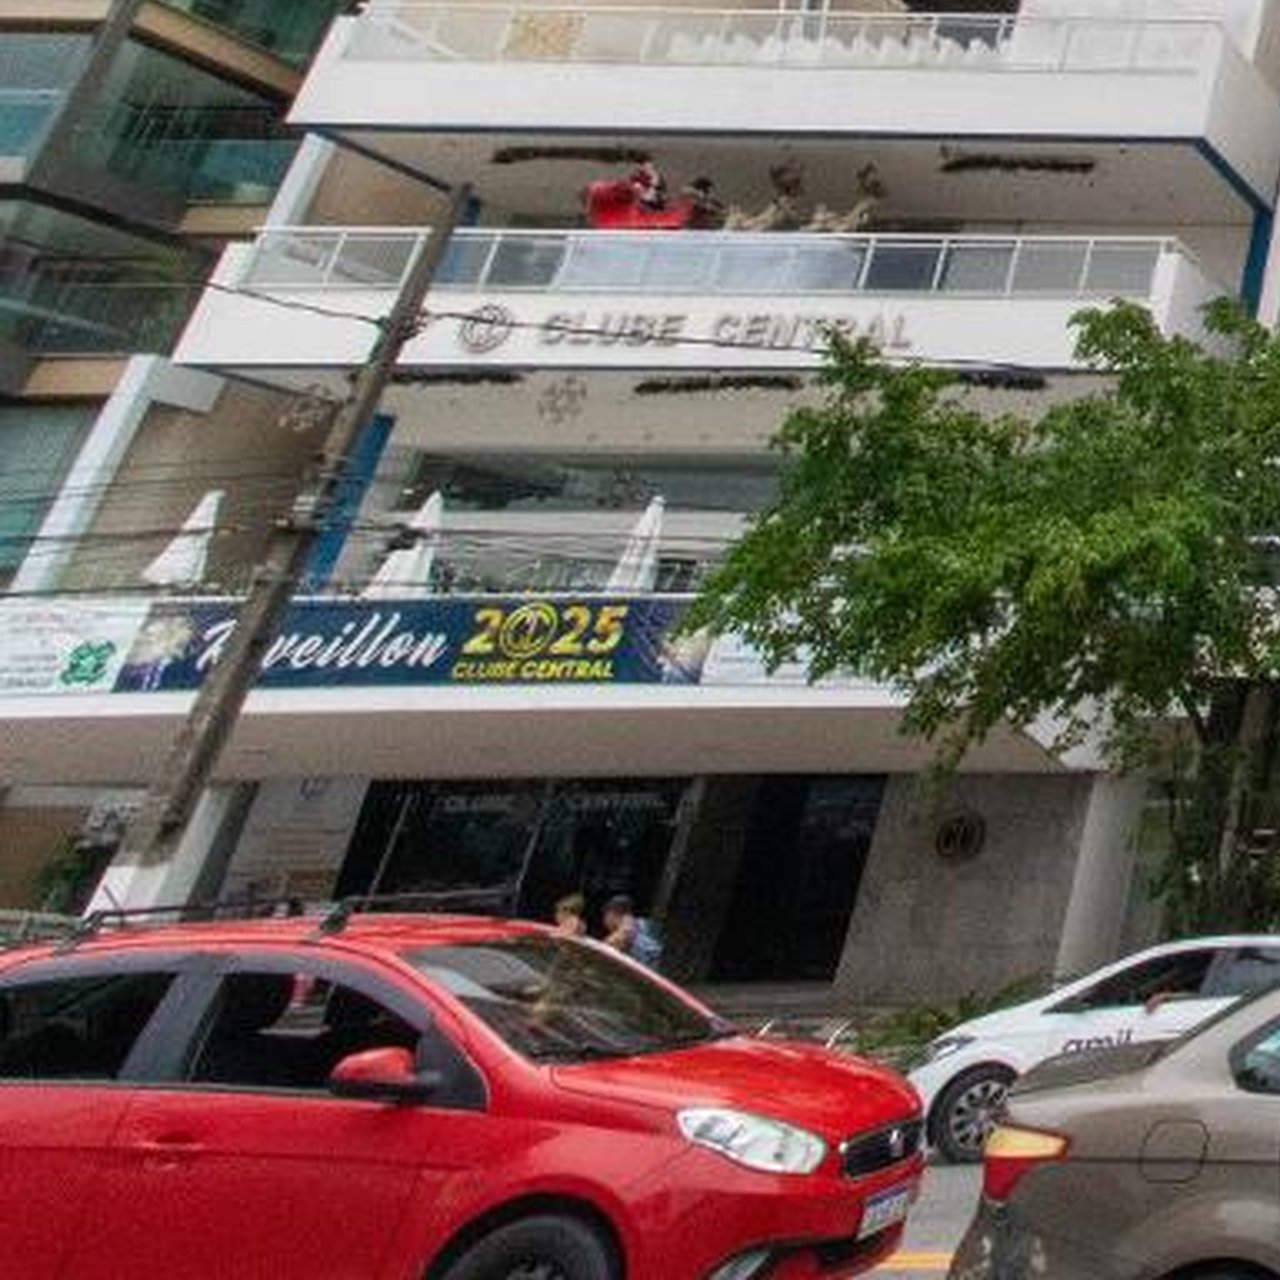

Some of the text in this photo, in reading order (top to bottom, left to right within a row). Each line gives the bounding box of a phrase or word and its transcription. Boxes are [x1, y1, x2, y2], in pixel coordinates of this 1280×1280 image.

[540, 313, 911, 349] CLUBE CENTRAL
[452, 660, 614, 679] CLUBE CENTRAL
